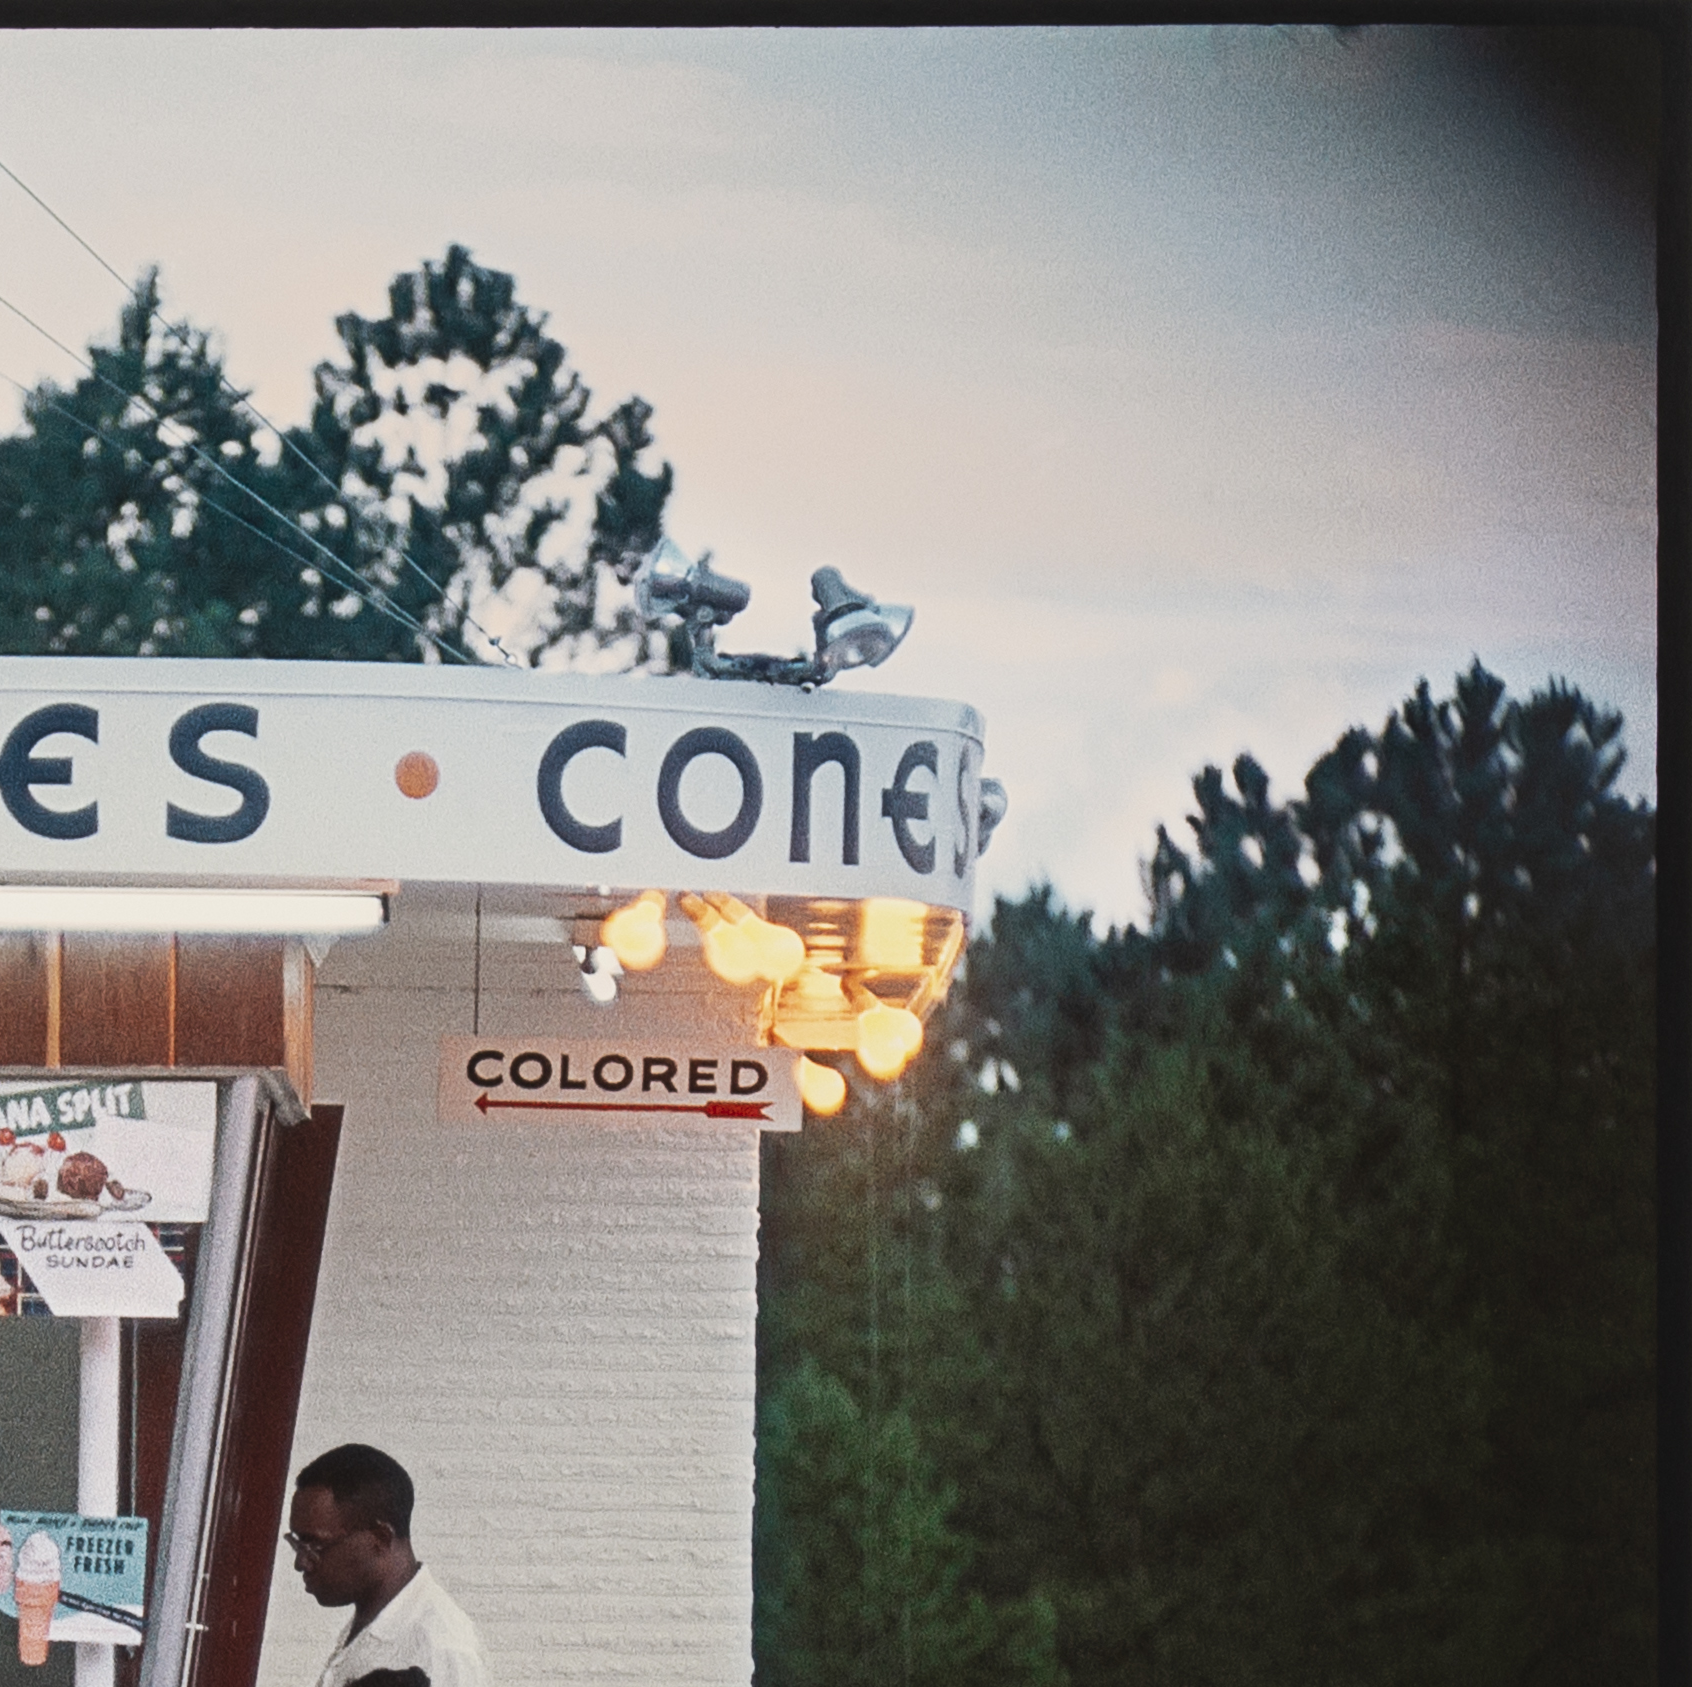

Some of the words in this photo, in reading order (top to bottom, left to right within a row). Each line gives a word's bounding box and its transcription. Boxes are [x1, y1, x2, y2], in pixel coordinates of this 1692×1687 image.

[536, 718, 977, 875] CONES
[466, 1050, 770, 1097] COLORED
[58, 1083, 133, 1123] SPLIT
[16, 1224, 146, 1254] Butterscotch
[46, 1255, 134, 1269] SUNDAE
[66, 1536, 135, 1555] FREEZER
[74, 1556, 125, 1575] FRESH
